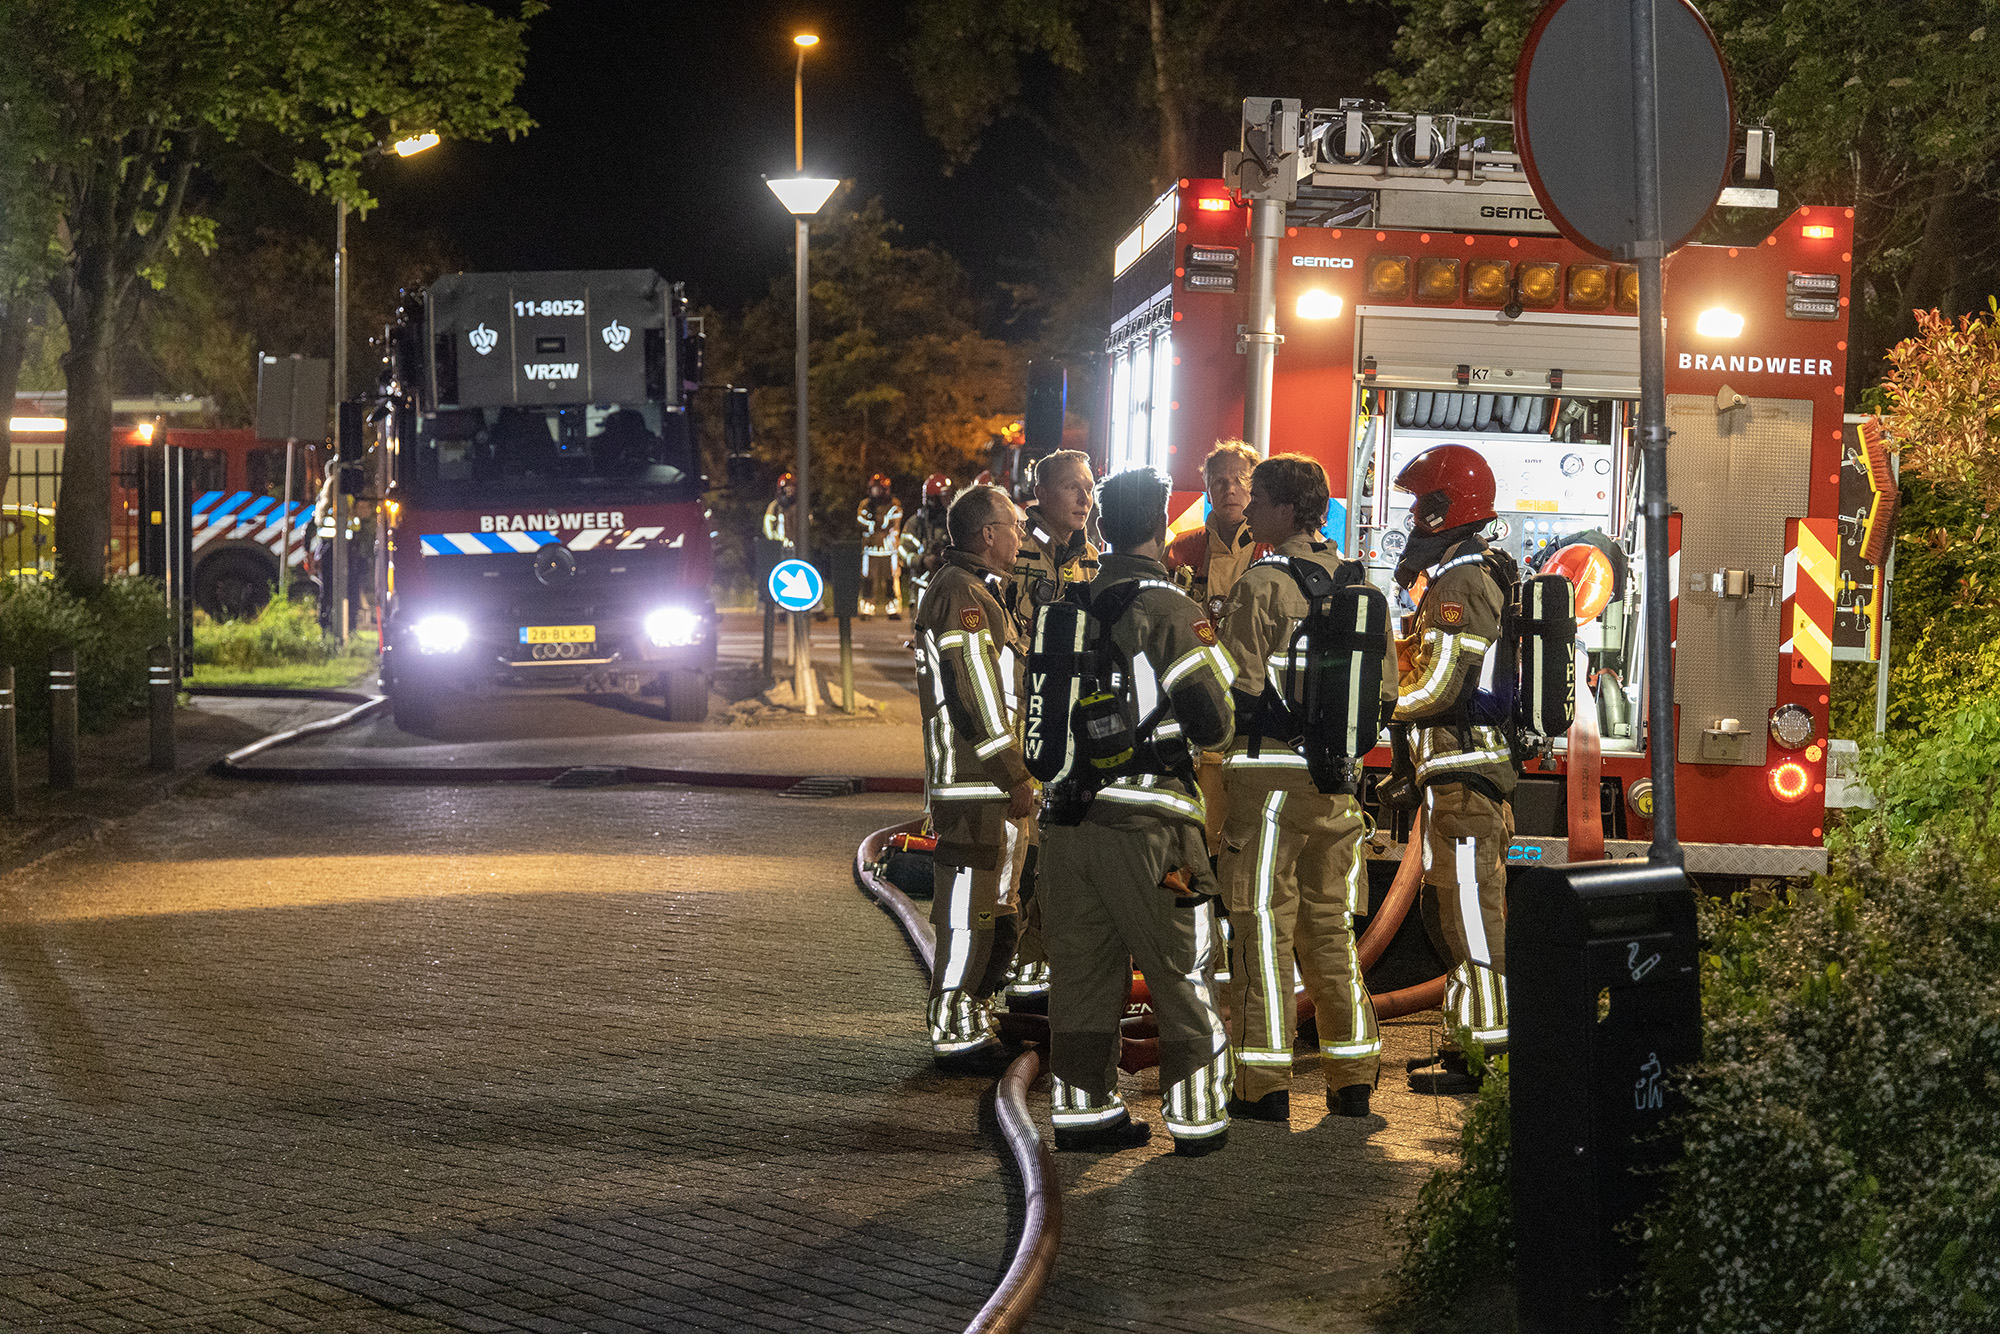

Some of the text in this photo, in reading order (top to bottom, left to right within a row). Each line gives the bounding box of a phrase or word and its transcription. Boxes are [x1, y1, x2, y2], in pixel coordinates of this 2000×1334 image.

[1480, 205, 1550, 220] GEMC
[1292, 255, 1354, 269] GEMCO
[514, 300, 585, 317] 11-8052
[524, 363, 580, 380] VRZW
[1678, 353, 1833, 376] BRANDWEER
[1472, 369, 1489, 380] K7
[480, 511, 625, 532] BRANDWEER
[1025, 673, 1047, 760] VRZW
